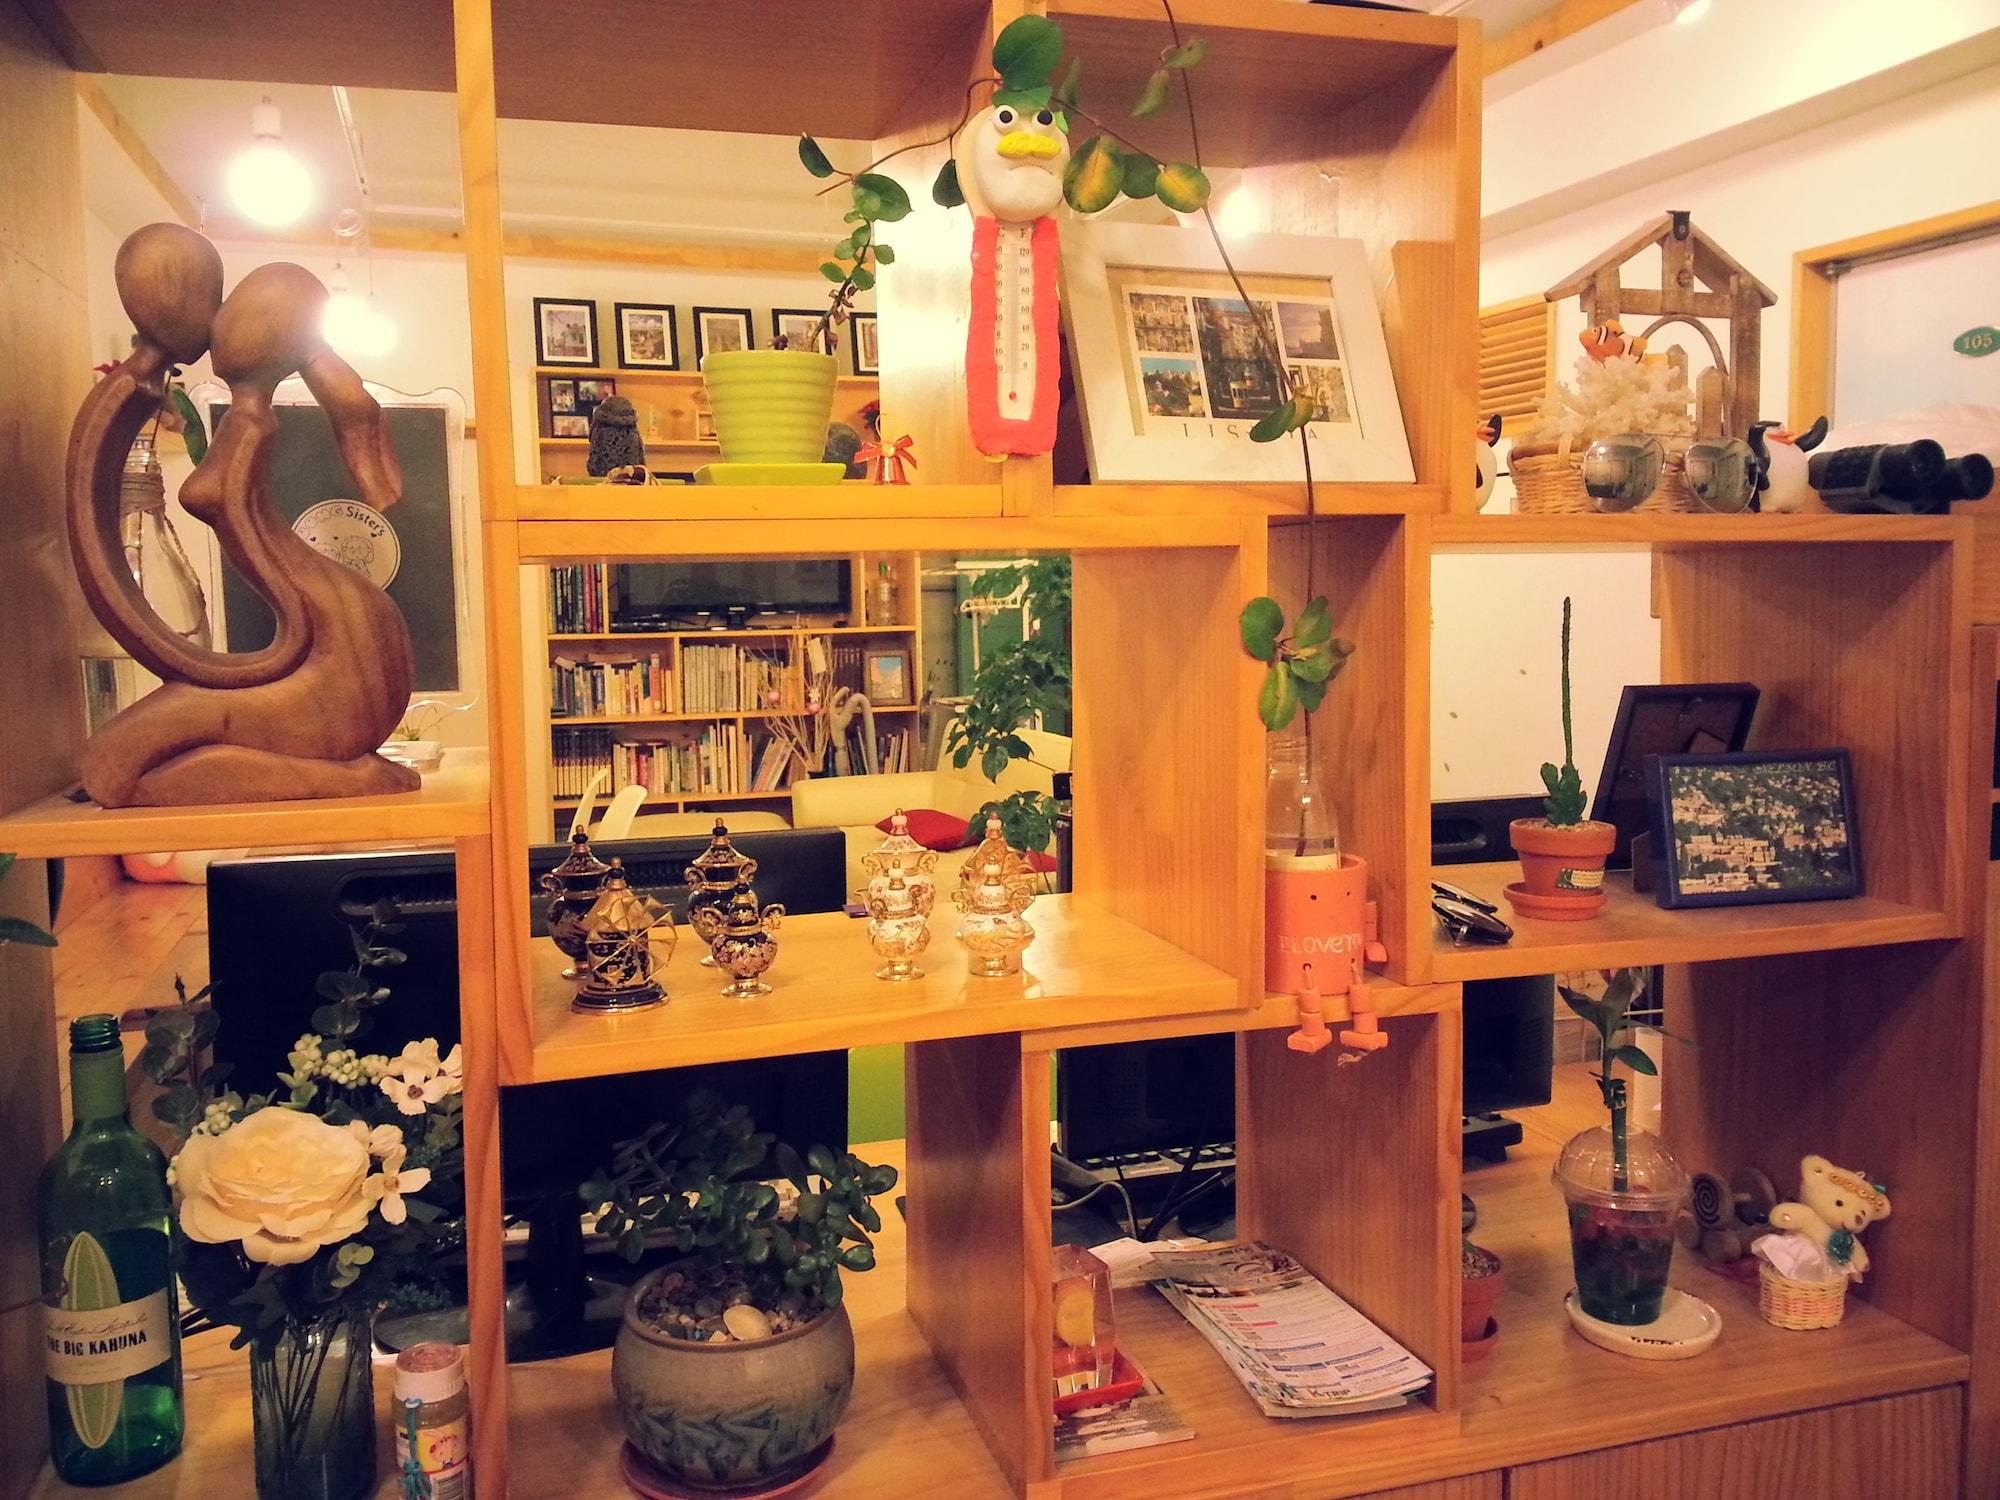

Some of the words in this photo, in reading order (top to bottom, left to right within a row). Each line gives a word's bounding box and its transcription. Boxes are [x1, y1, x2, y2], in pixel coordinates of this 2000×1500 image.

[1963, 333, 1994, 350] 105
[64, 1341, 84, 1356] BIG
[89, 1330, 147, 1355] KAHUNA
